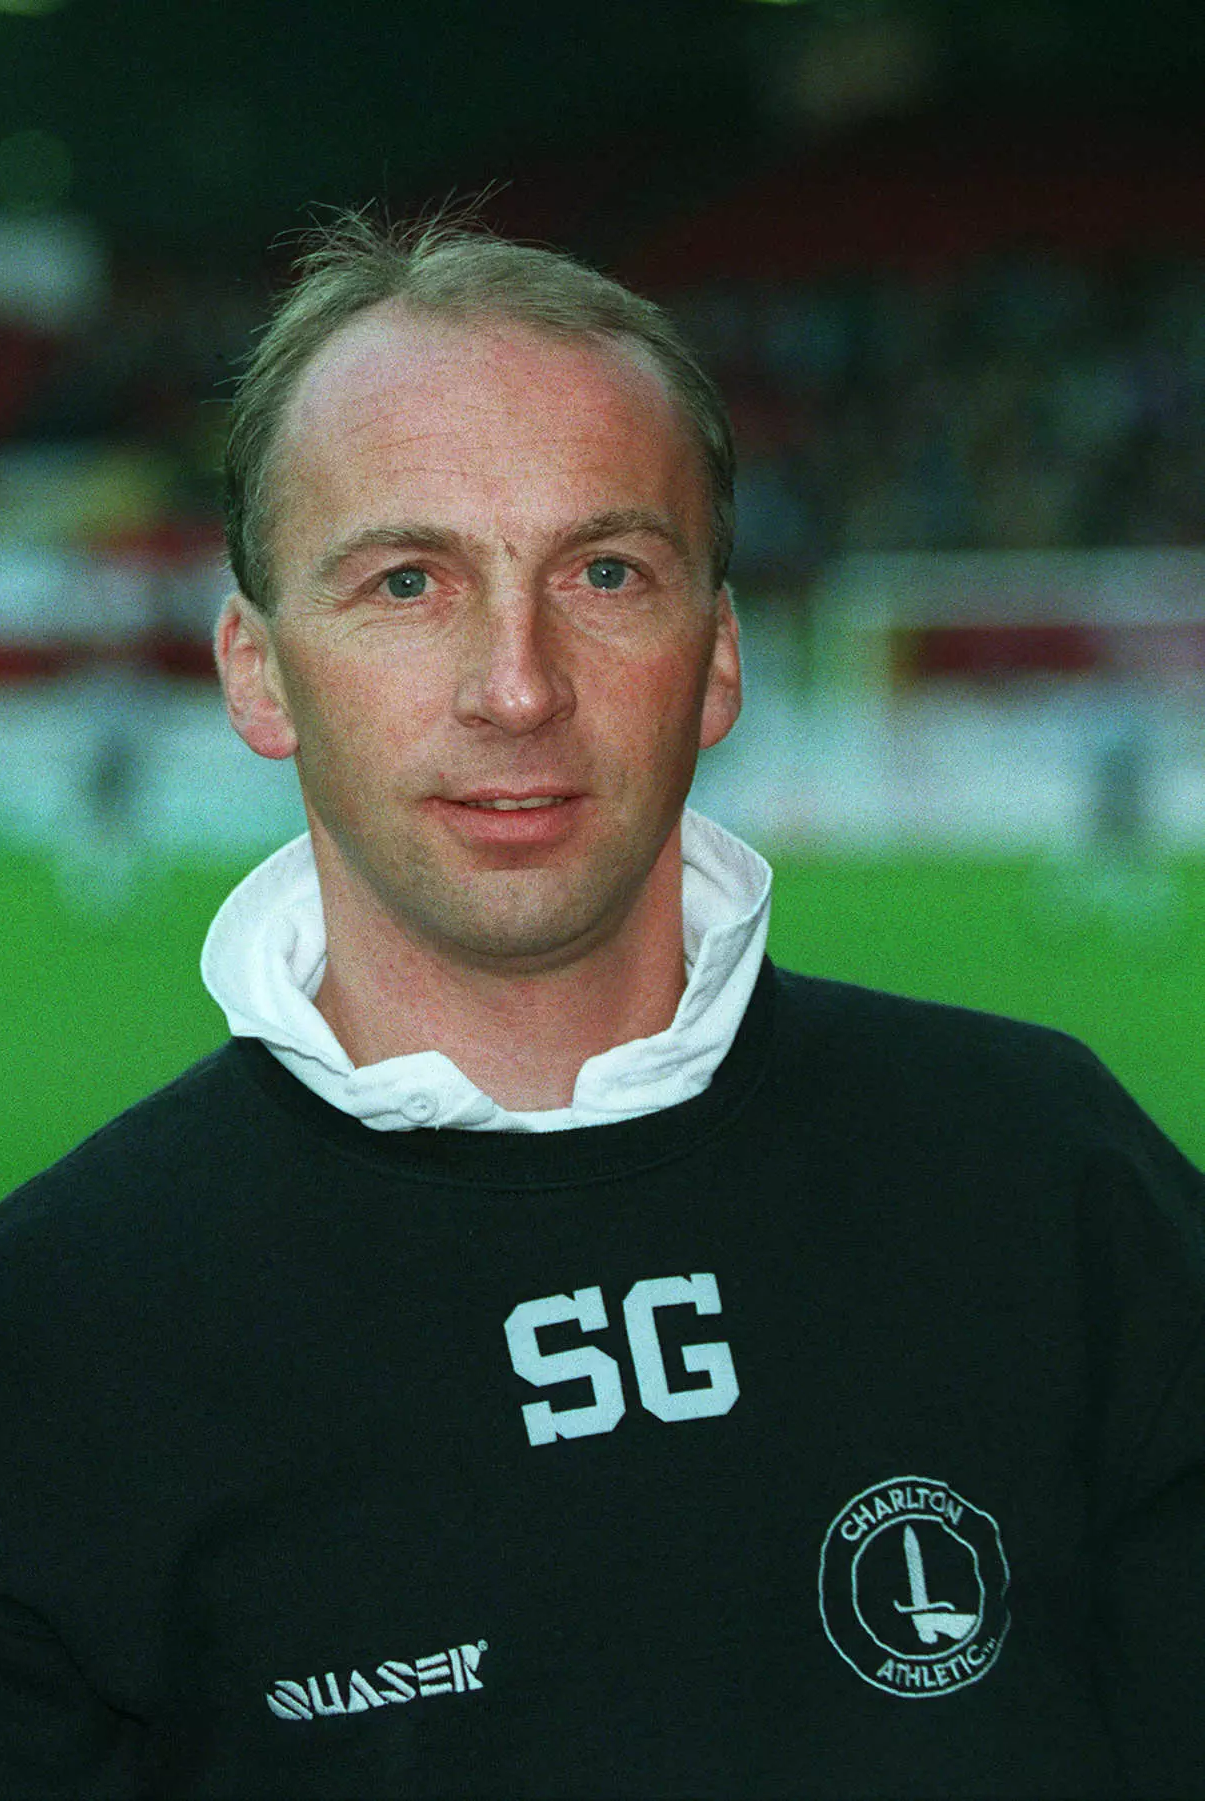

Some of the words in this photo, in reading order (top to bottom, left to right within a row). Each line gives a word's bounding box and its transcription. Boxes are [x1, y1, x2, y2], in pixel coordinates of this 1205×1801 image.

[503, 1272, 740, 1447] SG
[840, 1487, 963, 1541] CHARLTON
[266, 1644, 484, 1721] QUASER
[876, 1644, 986, 1688] ATHLETIC
